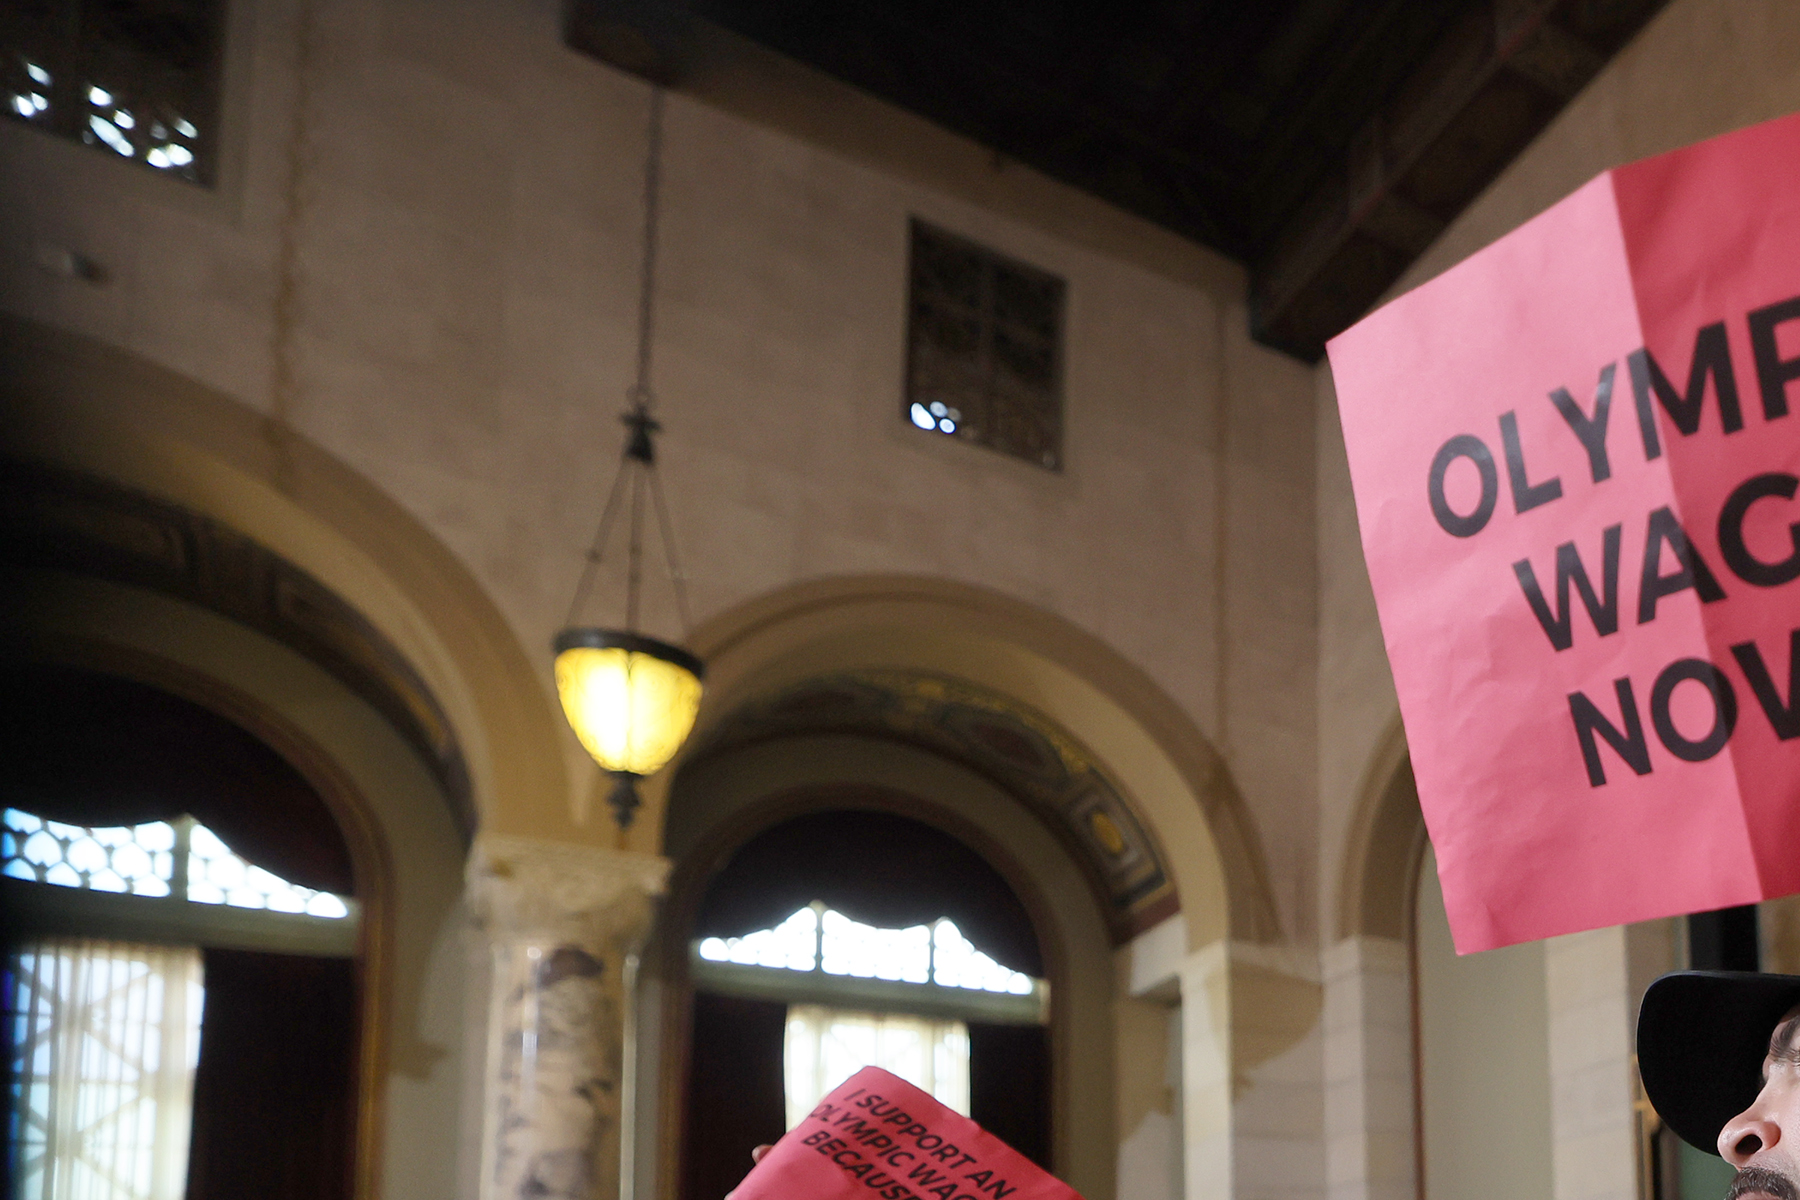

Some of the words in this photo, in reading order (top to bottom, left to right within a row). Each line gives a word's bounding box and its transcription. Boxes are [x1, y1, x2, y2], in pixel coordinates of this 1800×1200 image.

[811, 1103, 910, 1168] OLYMPIC
[845, 1088, 867, 1102] I
[856, 1093, 977, 1174] SUPPORT
[966, 1167, 1018, 1200] AN
